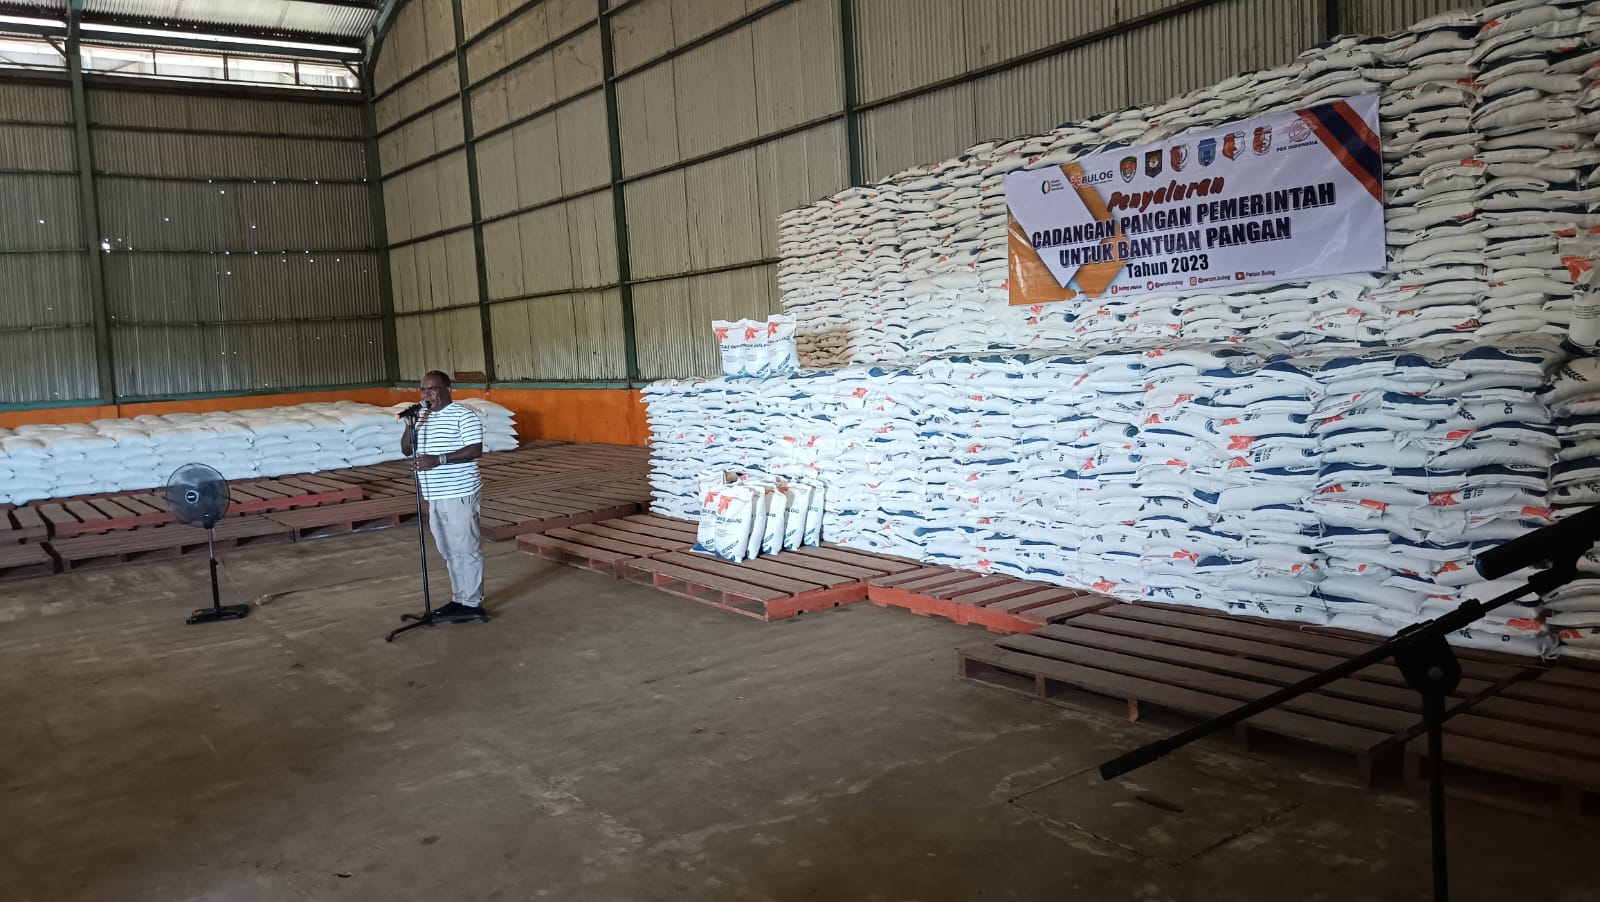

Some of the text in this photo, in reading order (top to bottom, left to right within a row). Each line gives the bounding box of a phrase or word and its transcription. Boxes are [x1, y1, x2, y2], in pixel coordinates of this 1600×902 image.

[1288, 140, 1318, 149] INDONESIA
[1082, 170, 1113, 184] BULOG
[1107, 176, 1225, 213] Penyaluran
[1032, 182, 1336, 249] CADANGAN PANGAN PEMERINTAH
[1059, 216, 1291, 268] UNTUK BANTUAN PANGAN
[1126, 253, 1209, 279] Tahun 2023
